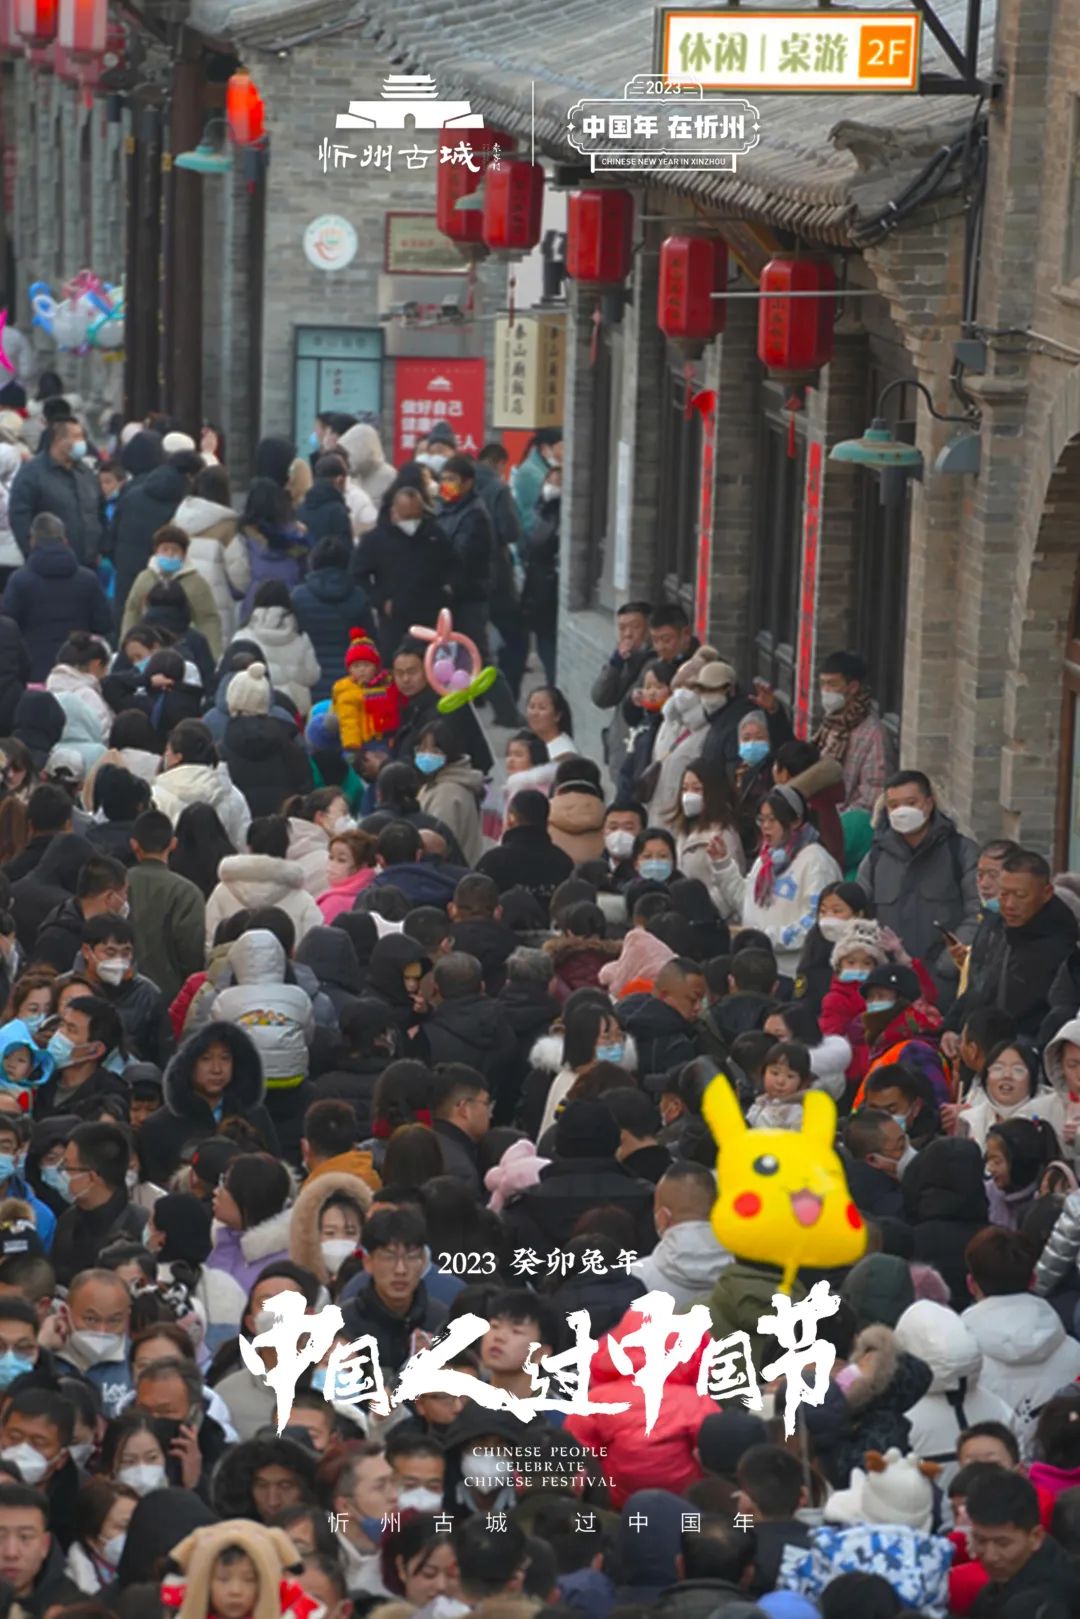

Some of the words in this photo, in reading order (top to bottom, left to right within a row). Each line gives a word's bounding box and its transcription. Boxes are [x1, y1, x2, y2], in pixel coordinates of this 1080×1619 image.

[678, 31, 748, 73] 休闲
[778, 31, 848, 73] 桌游
[867, 39, 906, 66] 2F
